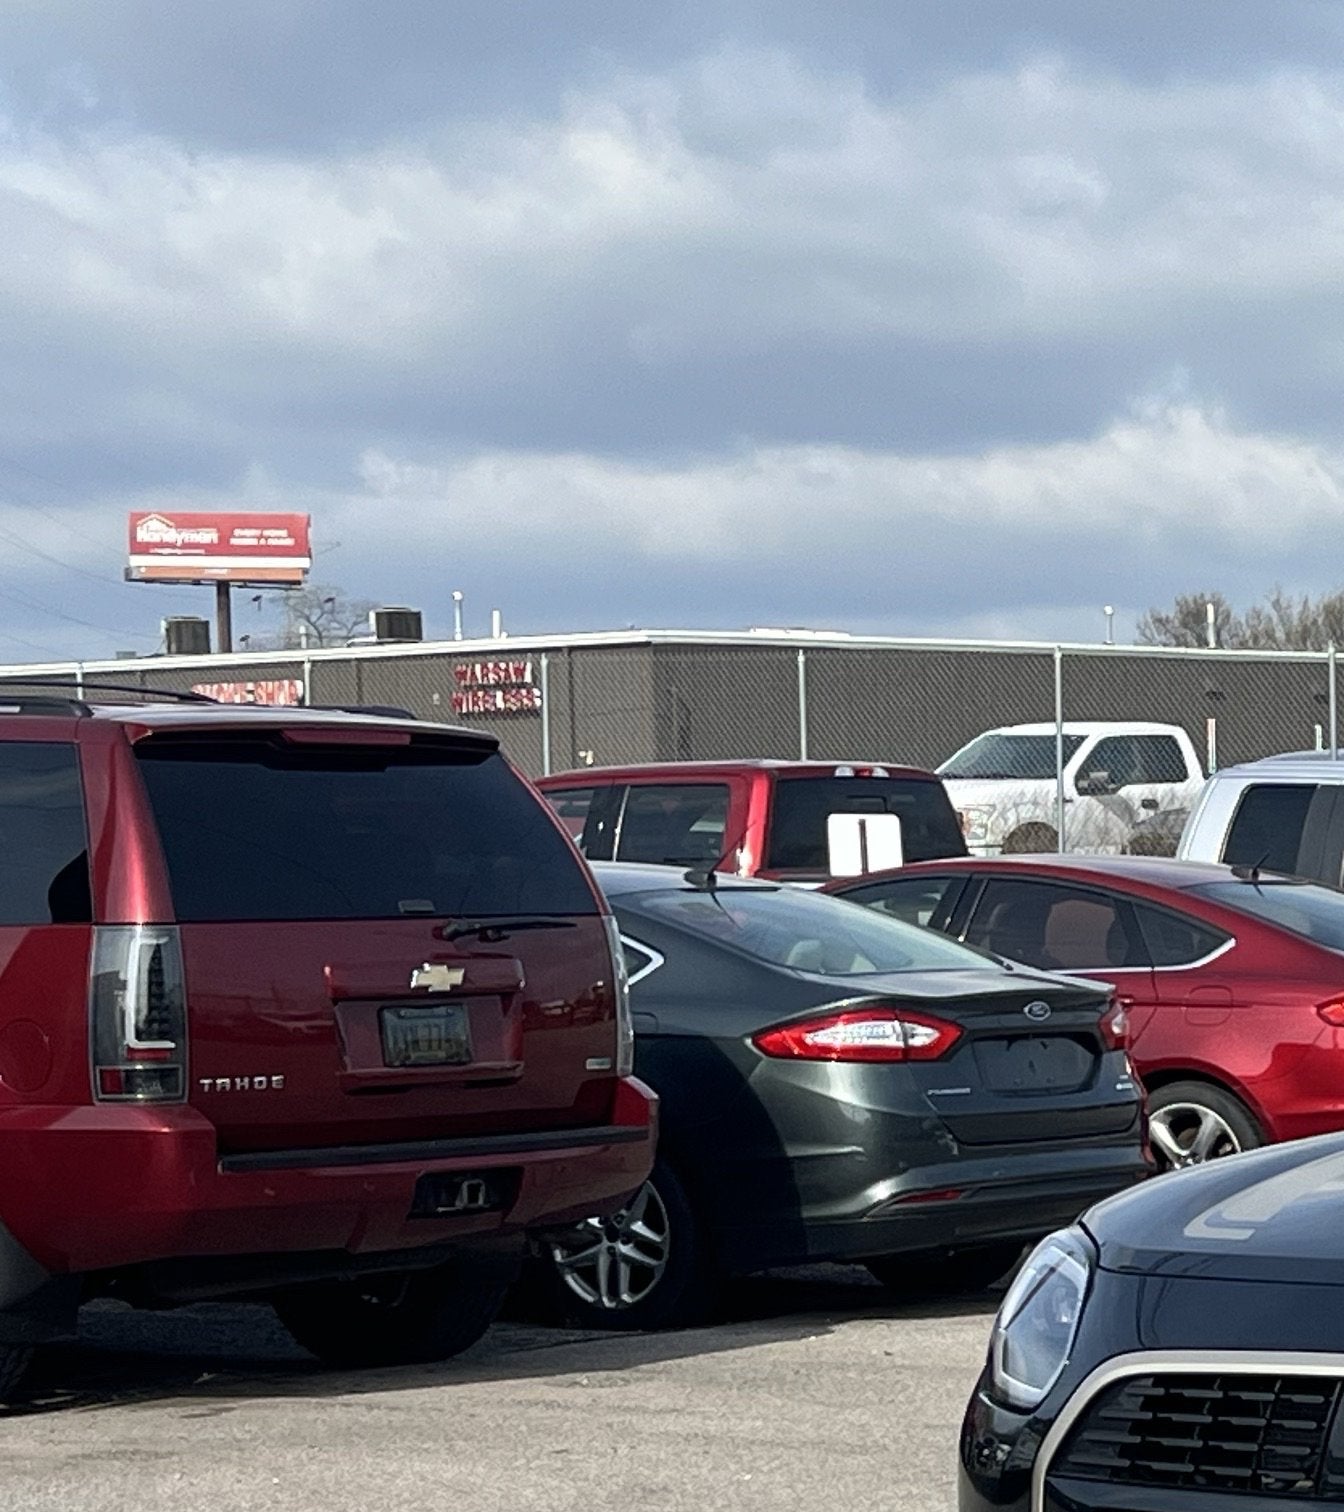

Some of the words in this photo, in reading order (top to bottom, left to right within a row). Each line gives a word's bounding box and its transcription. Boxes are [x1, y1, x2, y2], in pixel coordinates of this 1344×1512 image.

[136, 526, 219, 547] Handyman
[454, 661, 533, 685] WARSAW
[450, 687, 542, 714] WIRELESS
[199, 1075, 284, 1093] TAHOE
